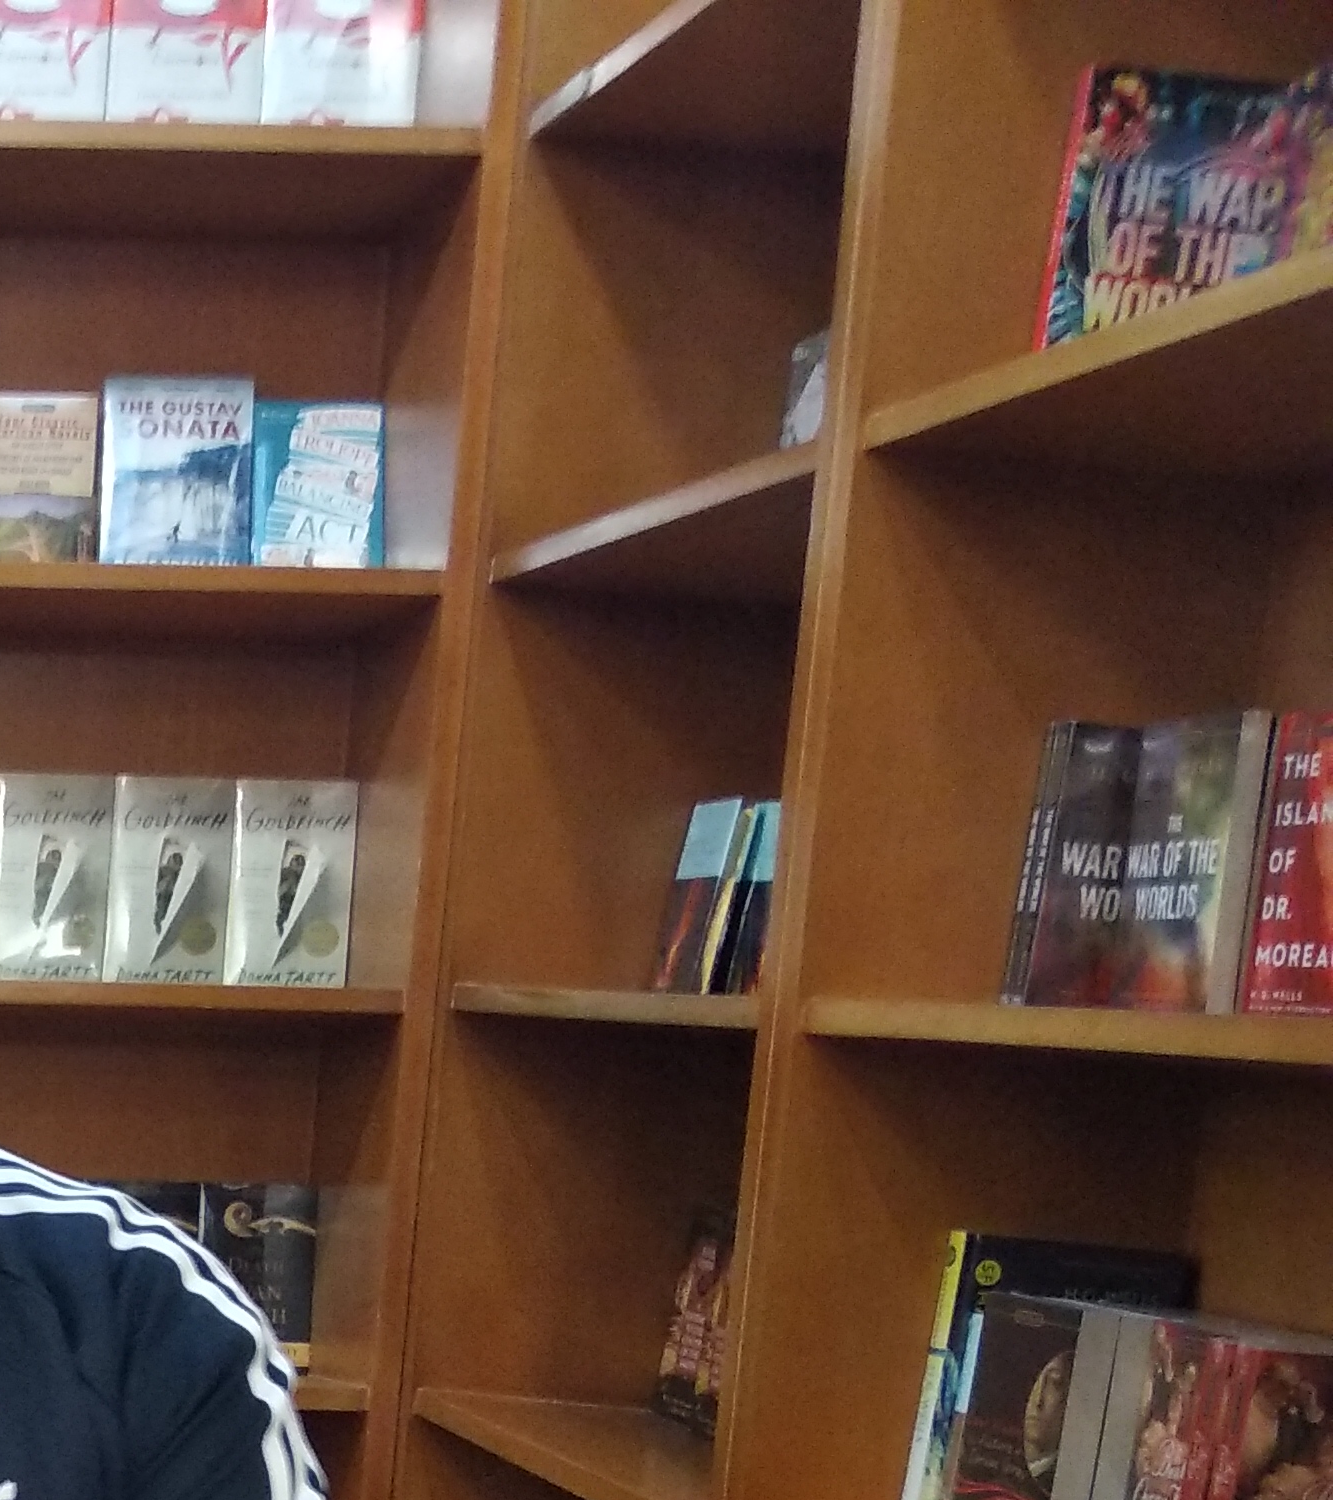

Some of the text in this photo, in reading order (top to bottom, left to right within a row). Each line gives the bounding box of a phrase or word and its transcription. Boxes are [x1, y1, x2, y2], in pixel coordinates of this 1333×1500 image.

[118, 400, 243, 418] THE GUSTAV
[297, 517, 365, 544] ACT
[1283, 752, 1322, 779] THE
[1061, 841, 1123, 881] WAR
[1127, 837, 1220, 879] WAR THE
[1269, 849, 1297, 874] OF
[1134, 883, 1200, 922] WORLDS
[1261, 896, 1292, 922] DR.
[162, 966, 215, 982] TARTT
[284, 968, 338, 985] TARTT
